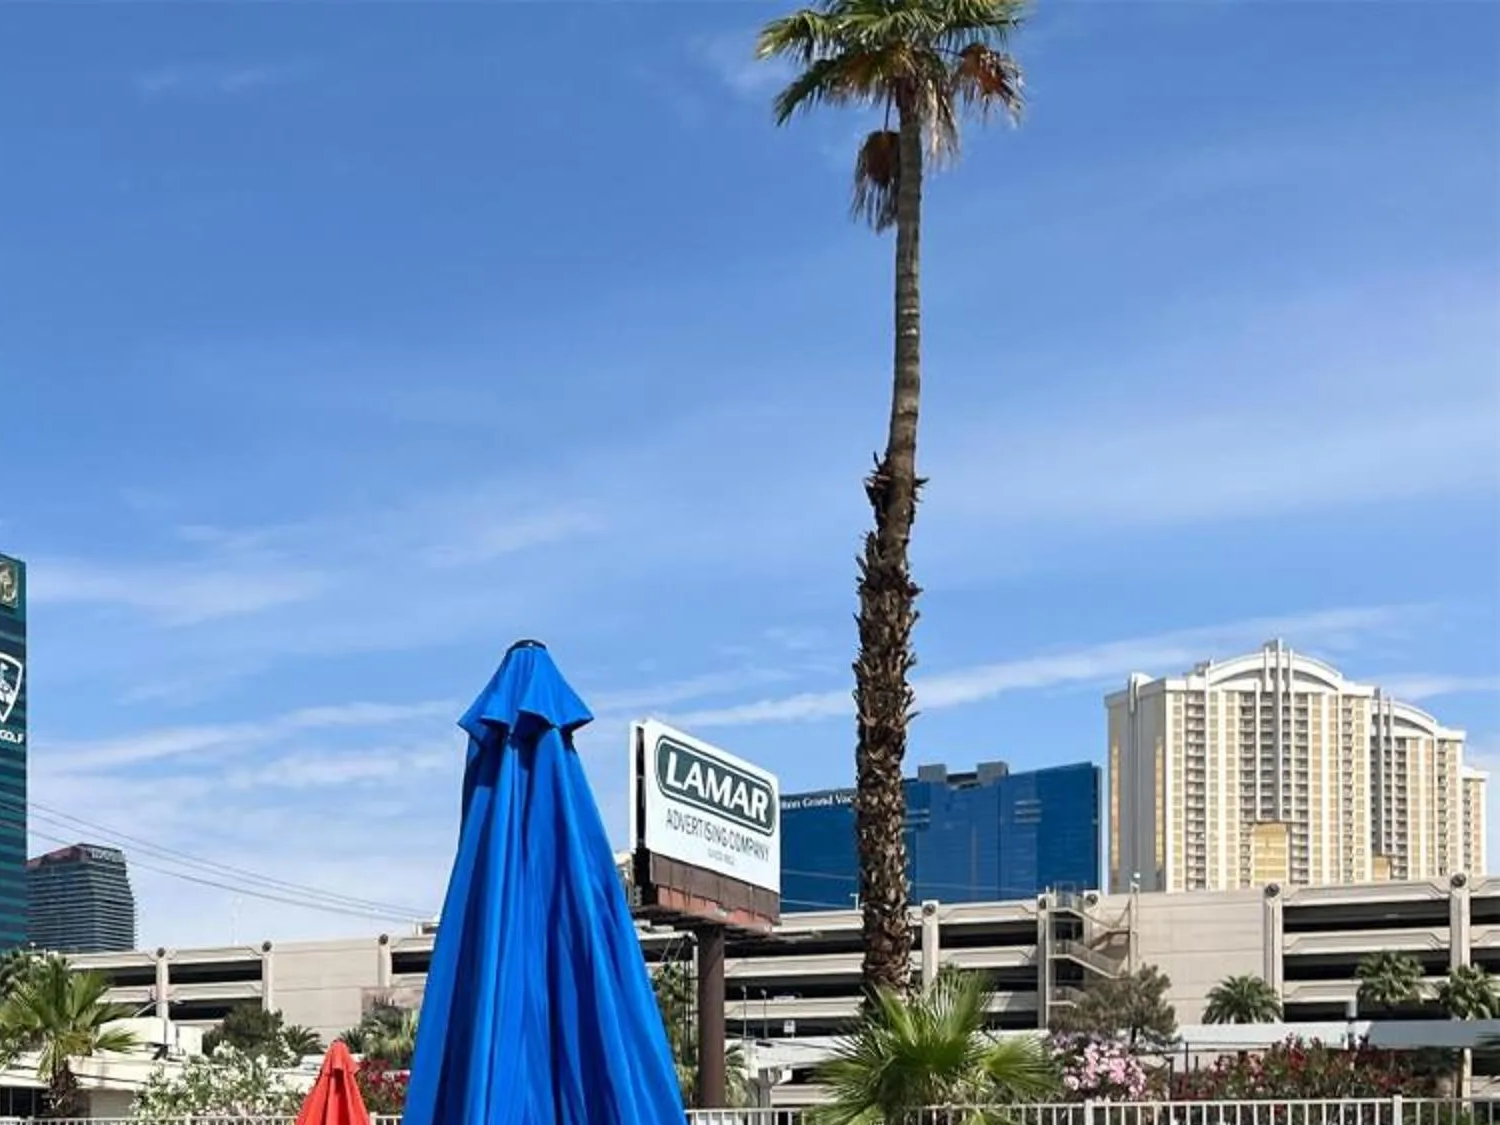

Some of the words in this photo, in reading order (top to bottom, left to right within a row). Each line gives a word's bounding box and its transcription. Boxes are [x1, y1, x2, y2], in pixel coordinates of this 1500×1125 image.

[665, 751, 769, 823] LAMAR
[665, 807, 728, 848] ADVERTISING
[728, 828, 770, 863] COMPANY
